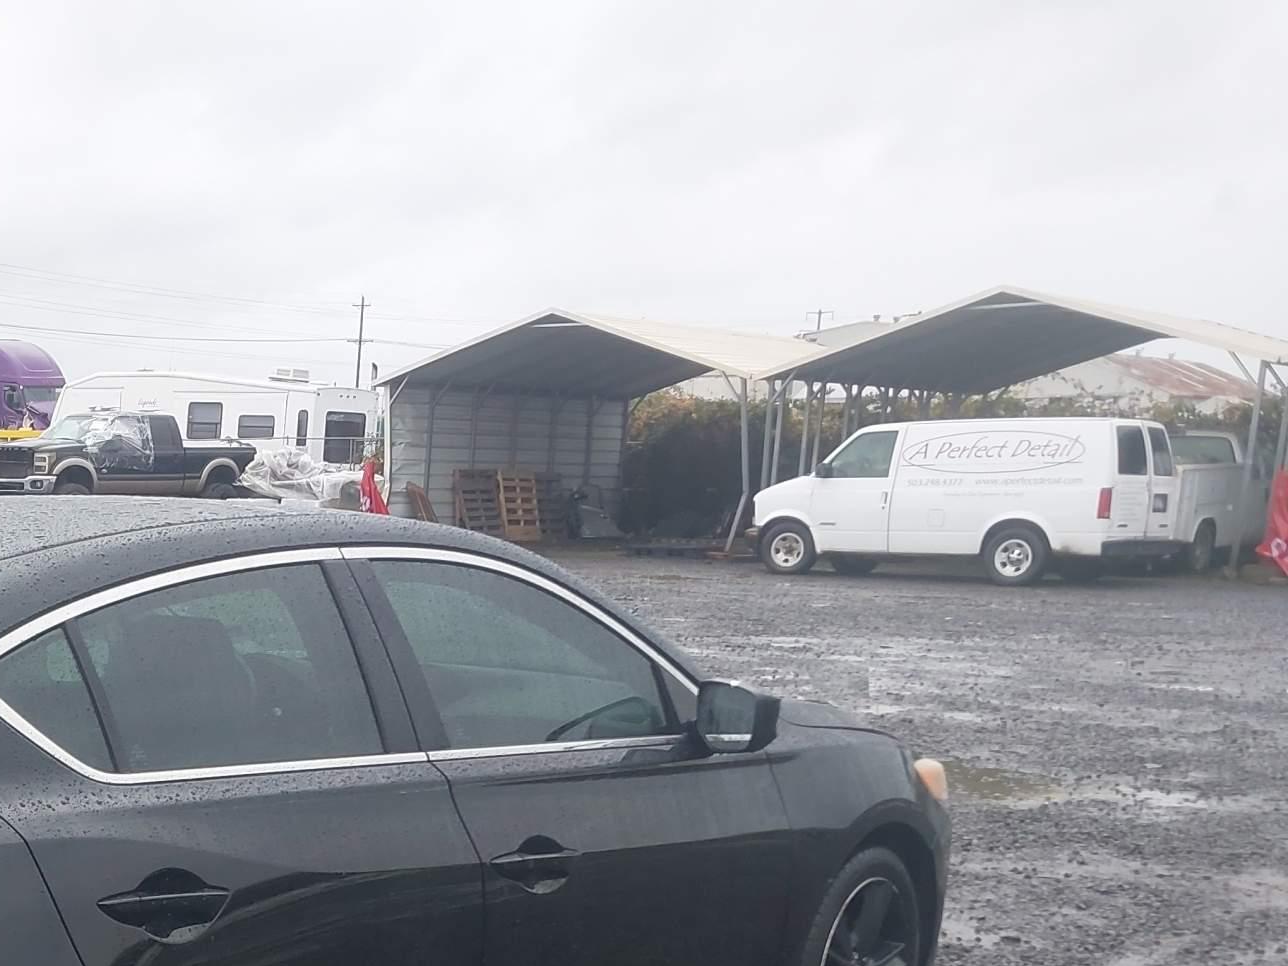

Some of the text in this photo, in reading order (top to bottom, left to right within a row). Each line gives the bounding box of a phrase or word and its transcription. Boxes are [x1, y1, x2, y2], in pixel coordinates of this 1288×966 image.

[908, 434, 1082, 460] A Perfect Detail
